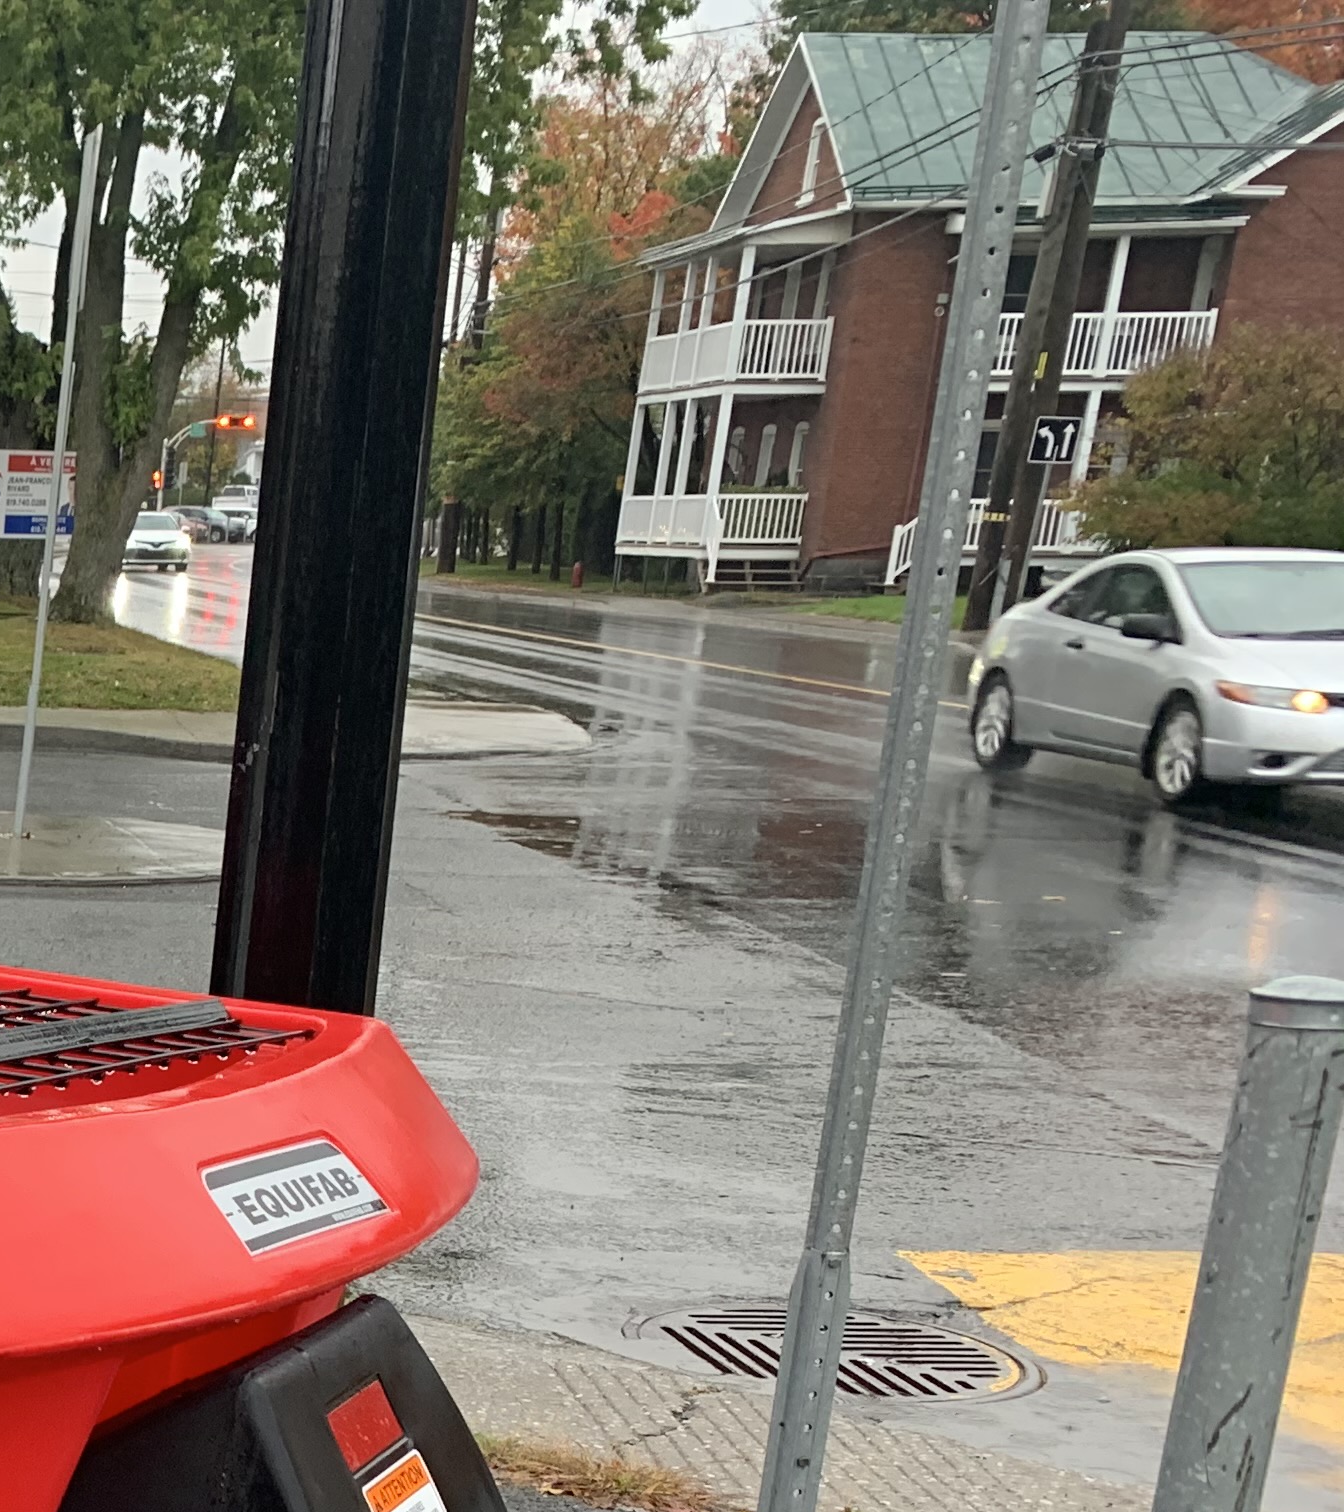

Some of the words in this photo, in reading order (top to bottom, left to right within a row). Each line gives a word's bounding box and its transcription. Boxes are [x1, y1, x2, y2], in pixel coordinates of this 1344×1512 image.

[39, 457, 76, 467] VERE
[232, 1167, 360, 1226] EQUIFAB
[379, 1462, 424, 1507] ATTENTION
